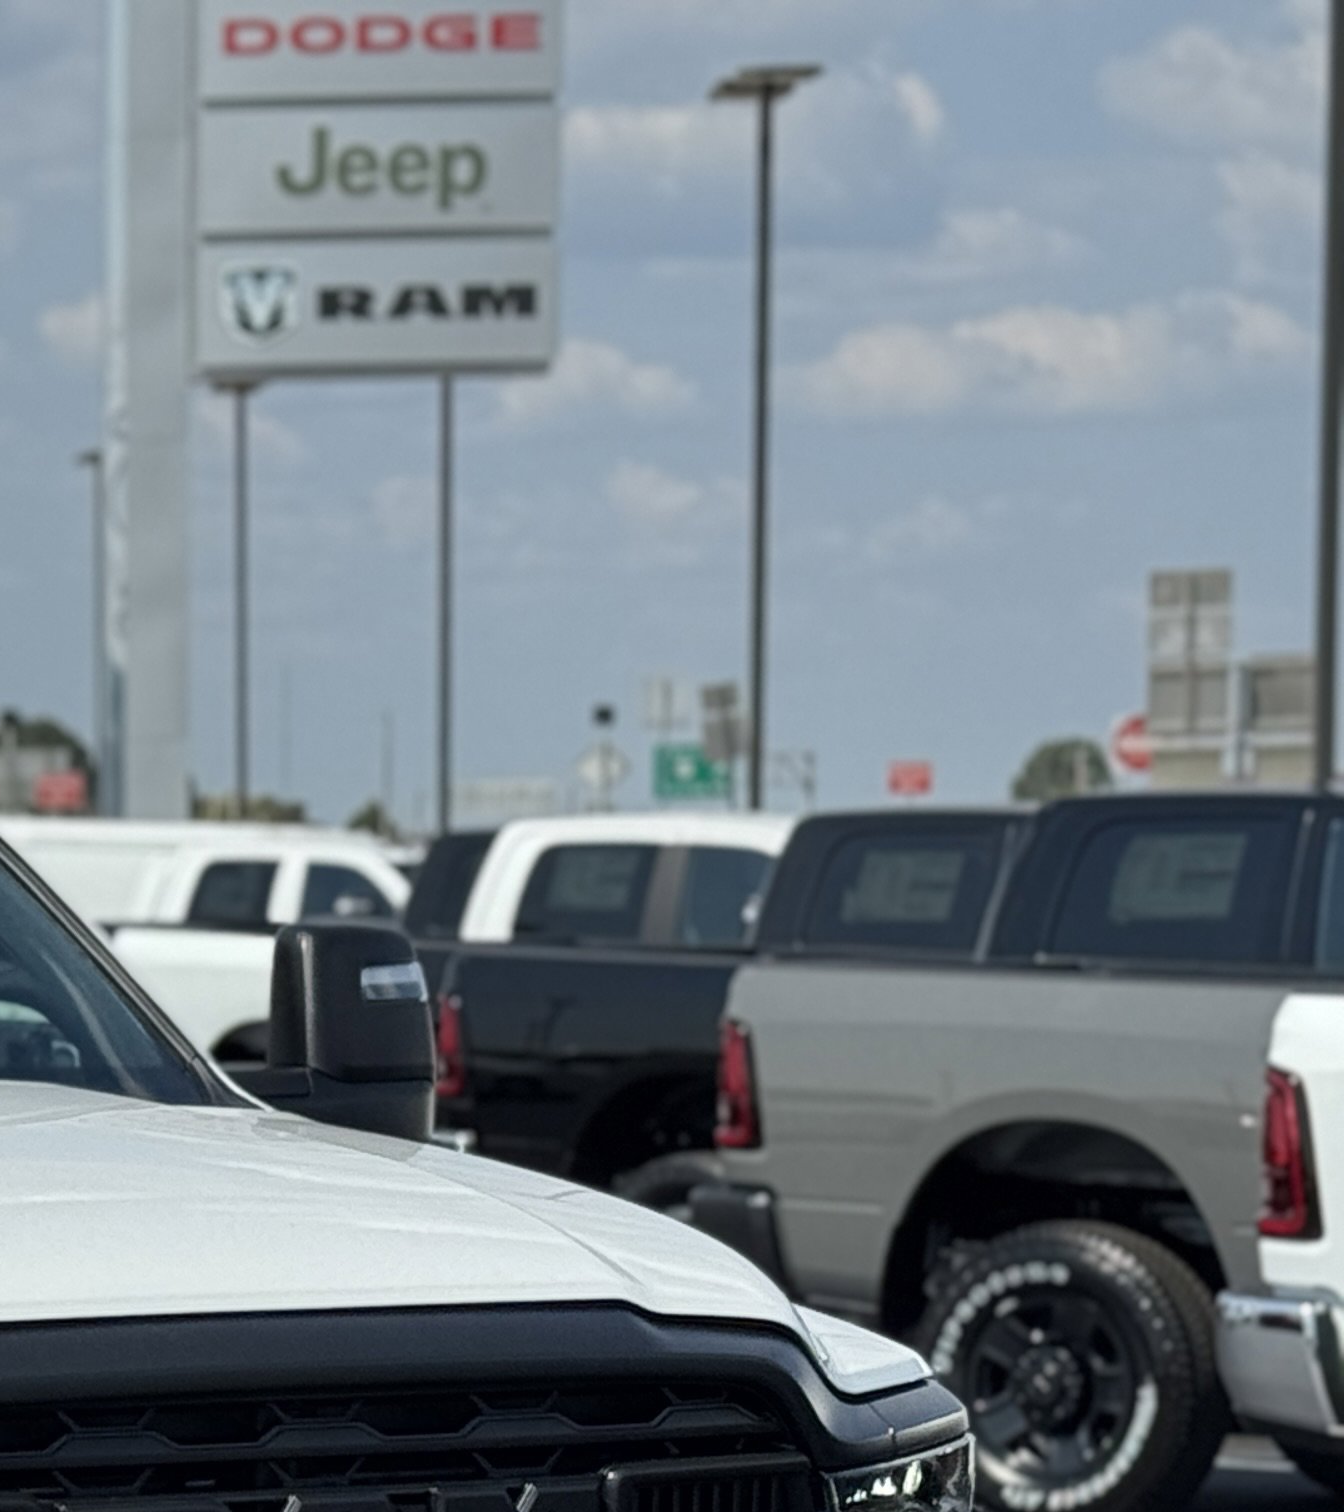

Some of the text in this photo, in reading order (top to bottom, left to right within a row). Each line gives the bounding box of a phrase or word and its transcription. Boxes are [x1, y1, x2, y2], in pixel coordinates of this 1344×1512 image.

[221, 14, 543, 56] DODGE
[275, 124, 488, 211] Jeep
[316, 283, 539, 322] RAM
